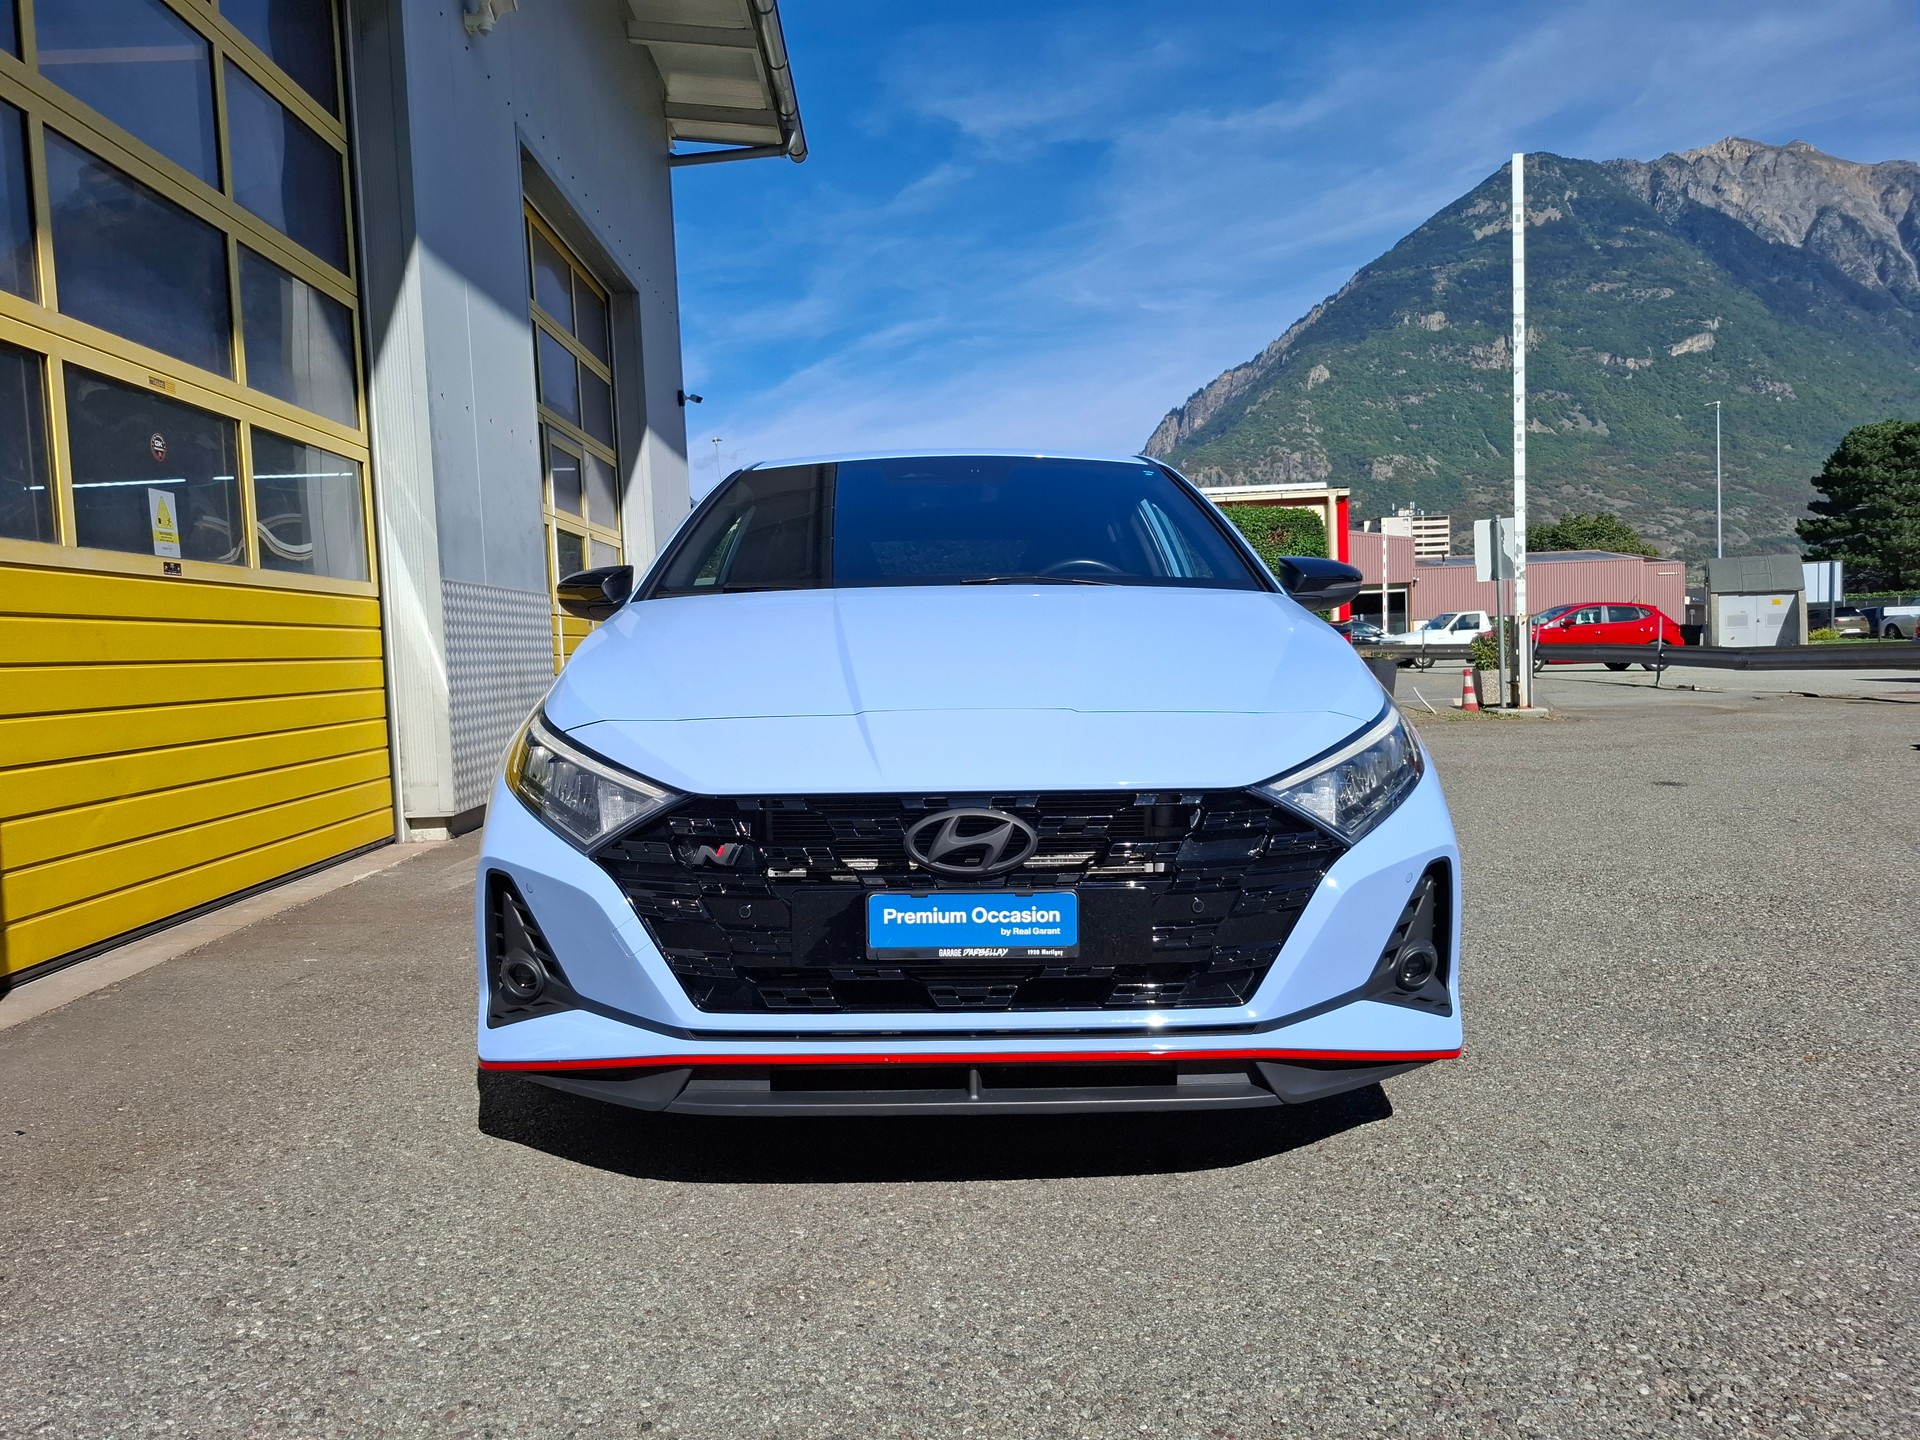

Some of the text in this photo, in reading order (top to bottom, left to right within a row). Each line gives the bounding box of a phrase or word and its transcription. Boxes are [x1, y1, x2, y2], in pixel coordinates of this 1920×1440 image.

[883, 906, 1061, 925] Premium Occasion
[1000, 927, 1061, 937] by Real Garant
[938, 948, 962, 957] GARAGE
[1041, 949, 1064, 957] Martigny
